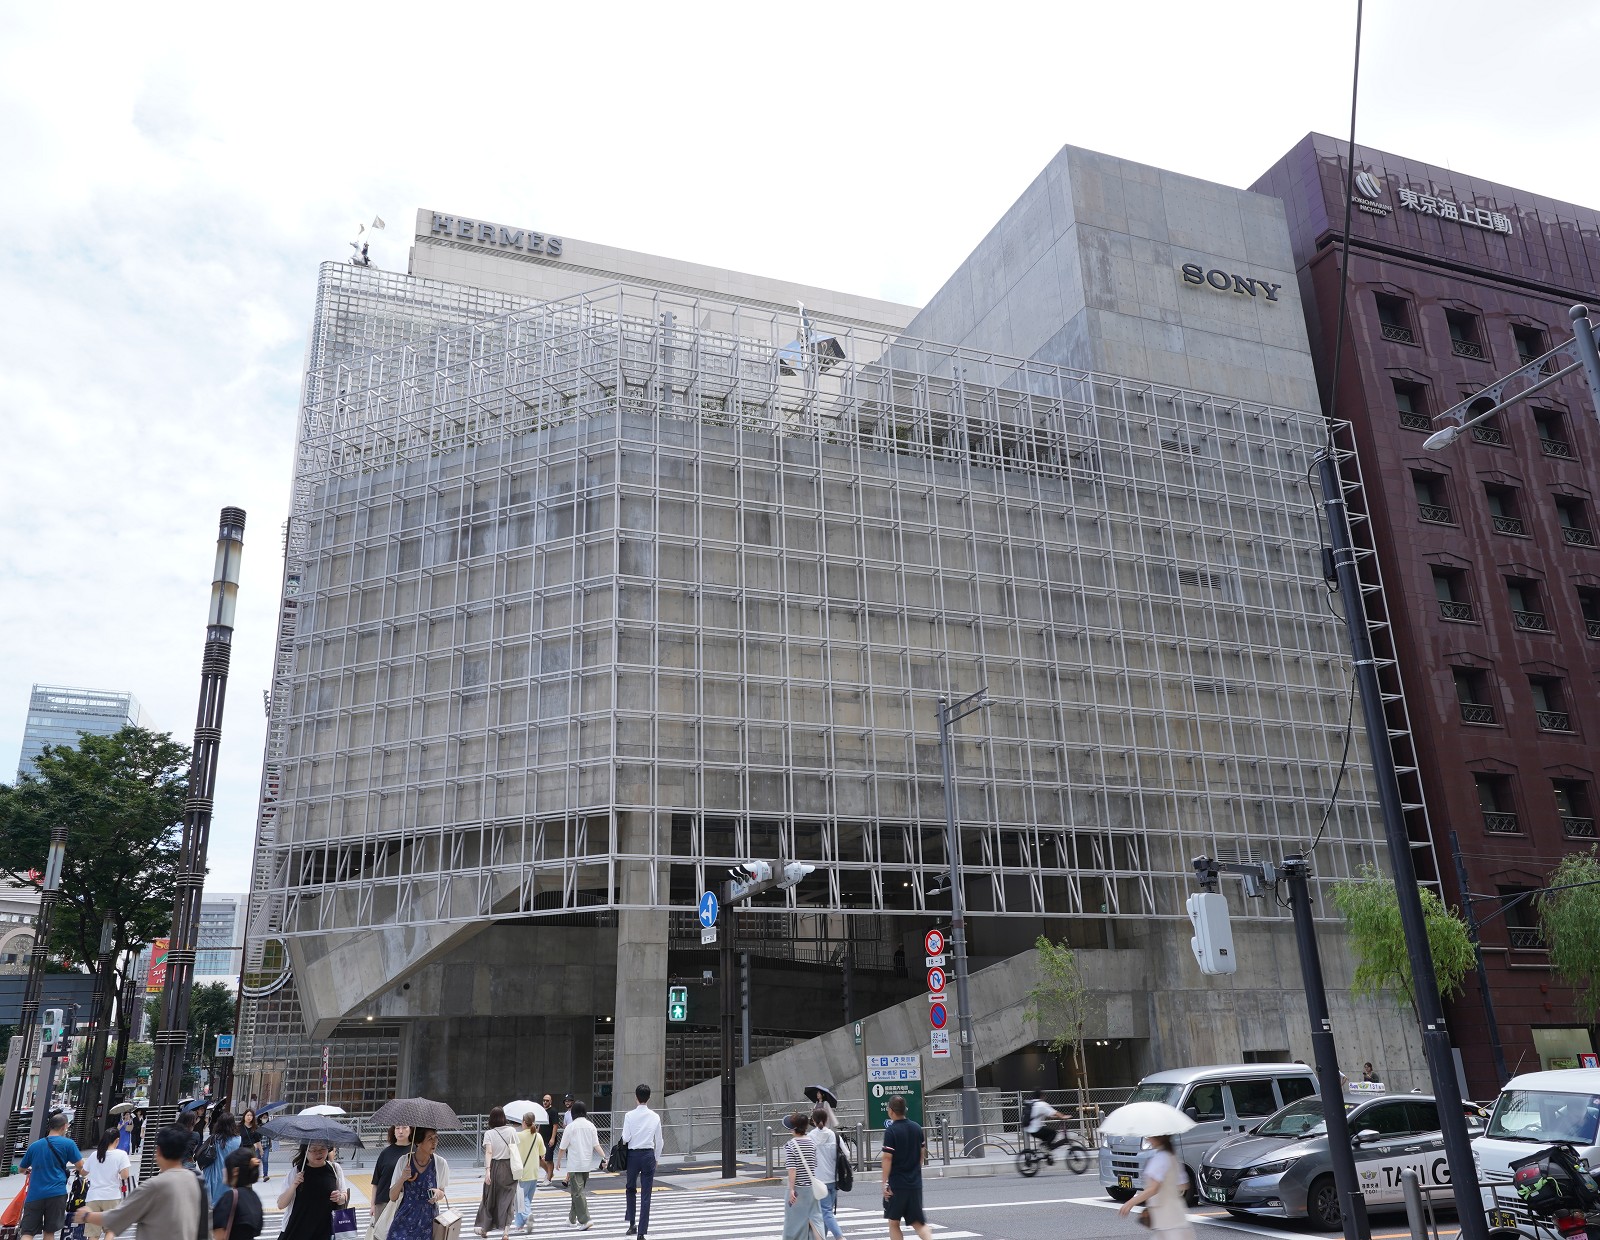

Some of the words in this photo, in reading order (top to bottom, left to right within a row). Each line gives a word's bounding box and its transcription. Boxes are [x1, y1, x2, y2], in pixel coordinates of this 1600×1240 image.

[1397, 187, 1514, 235] 東京海上日動
[1181, 262, 1282, 302] SONY
